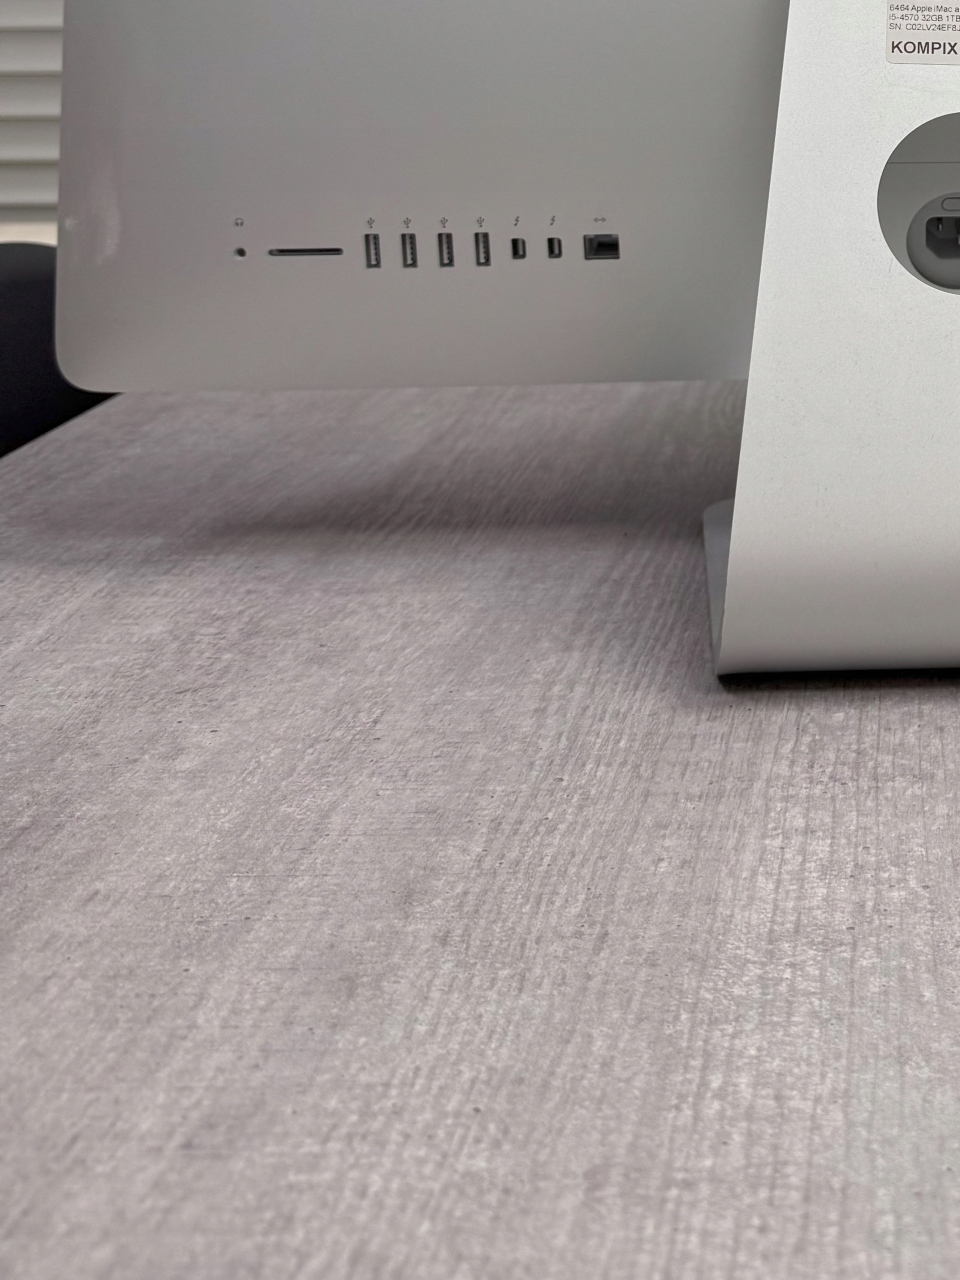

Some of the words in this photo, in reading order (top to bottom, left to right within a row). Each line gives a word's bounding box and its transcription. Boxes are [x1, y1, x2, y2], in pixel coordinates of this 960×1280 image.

[910, 4, 933, 13] Apple
[933, 5, 953, 13] iMac
[889, 13, 919, 21] i5-4570
[921, 14, 944, 22] 32GB
[891, 40, 959, 55] KOMPIX
